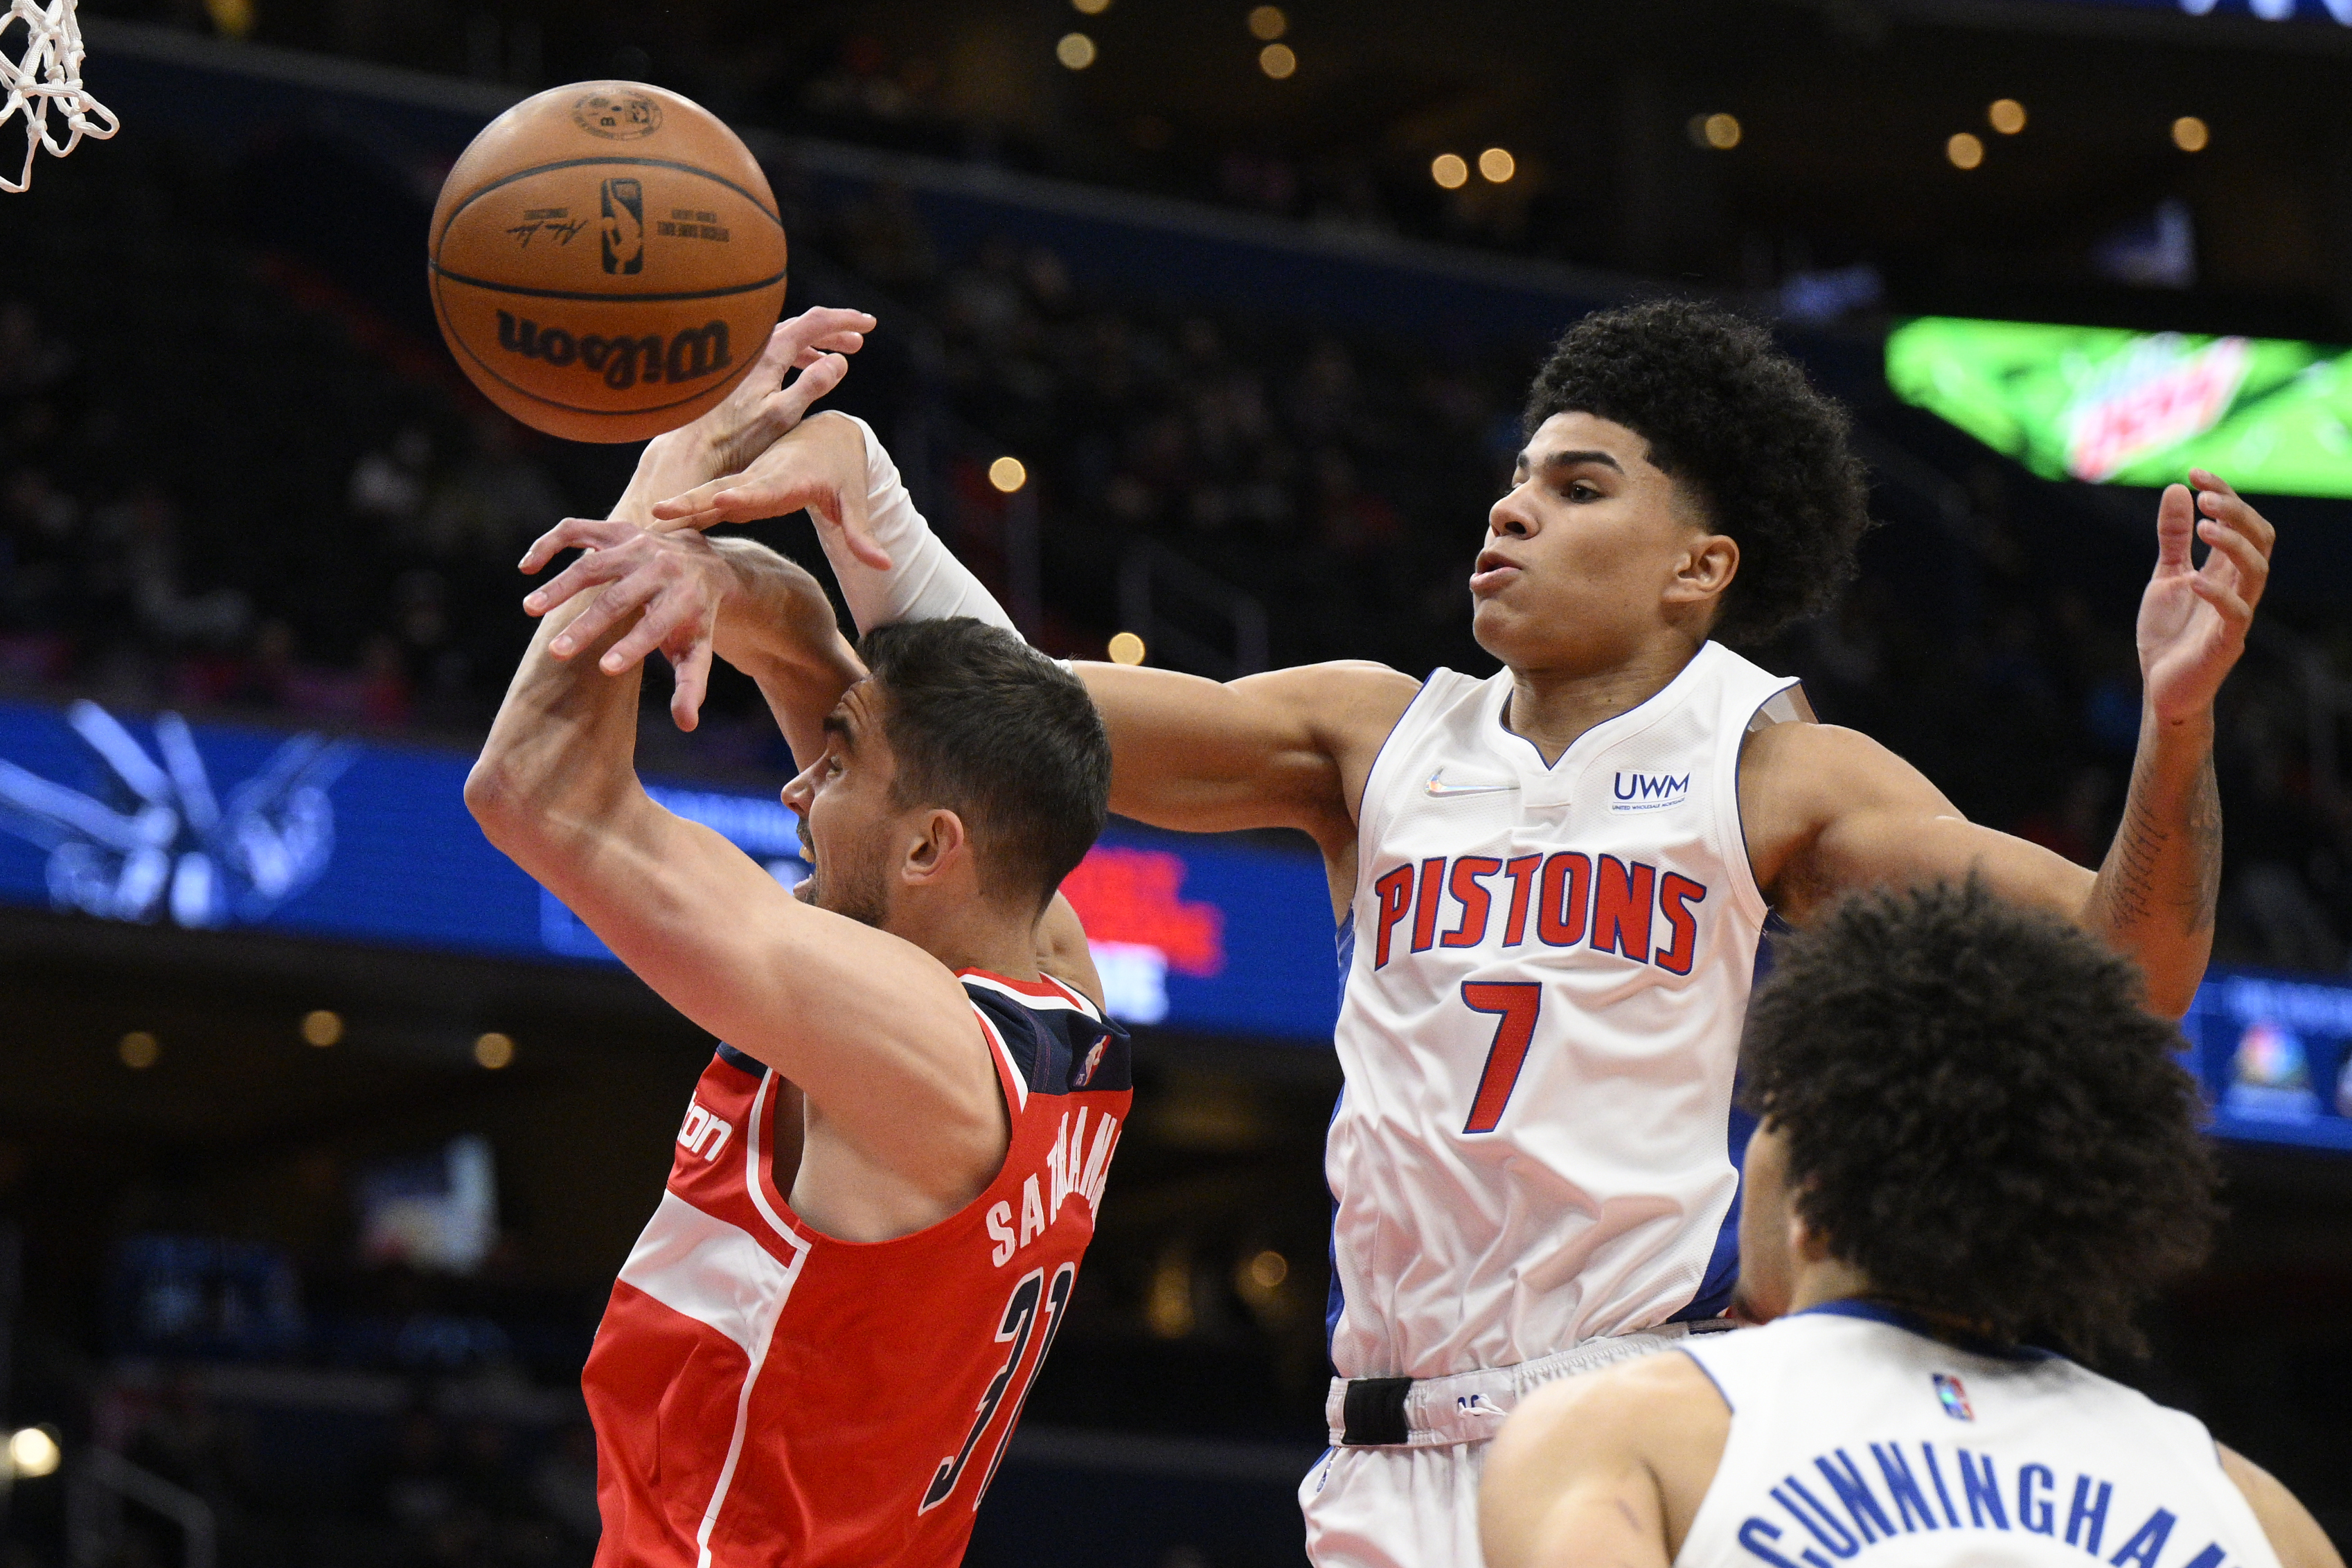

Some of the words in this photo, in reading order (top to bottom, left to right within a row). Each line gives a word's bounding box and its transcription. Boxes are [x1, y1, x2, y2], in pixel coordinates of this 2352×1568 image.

[497, 309, 732, 390] Wilson
[1614, 772, 1690, 800] UWM
[1374, 851, 1707, 977] PISTONS
[1461, 980, 1542, 1134] 7
[918, 1261, 1075, 1517] 31
[1738, 1441, 2229, 1568] CUNNINGHA
